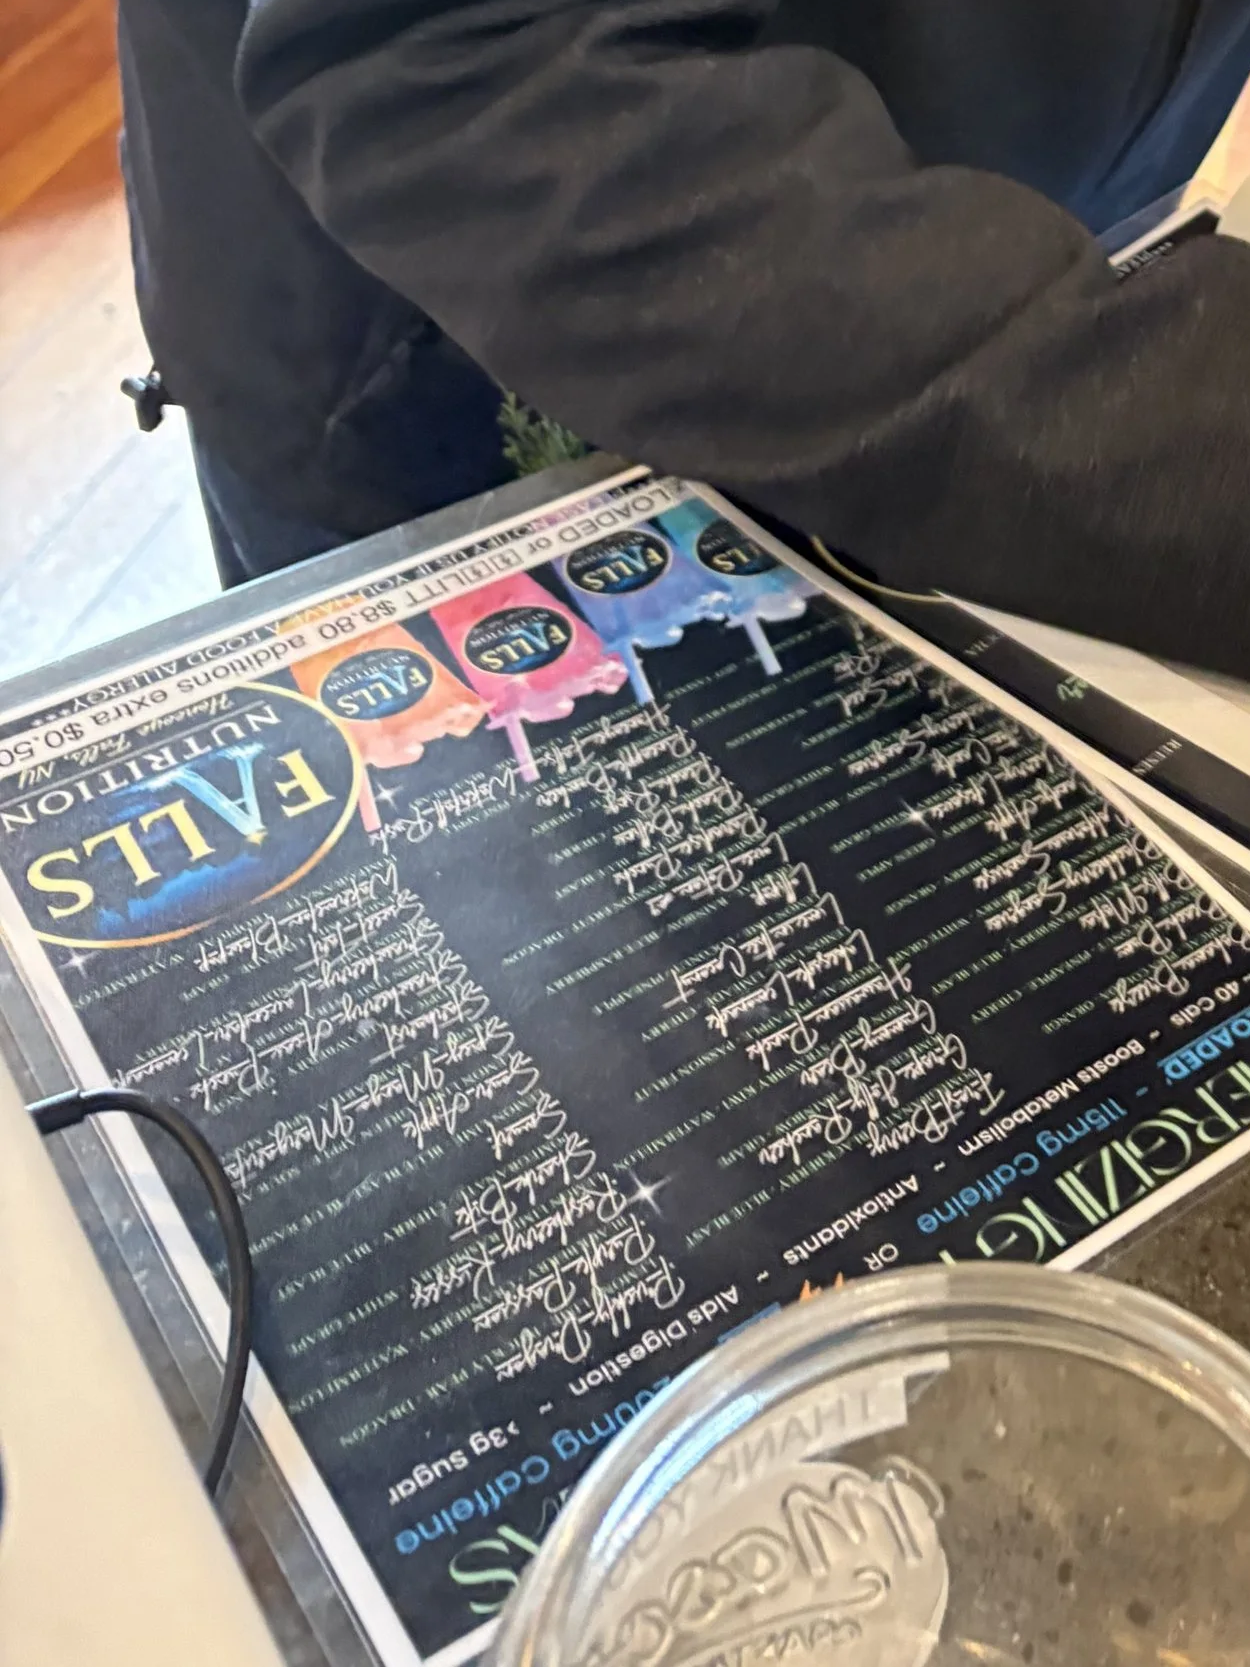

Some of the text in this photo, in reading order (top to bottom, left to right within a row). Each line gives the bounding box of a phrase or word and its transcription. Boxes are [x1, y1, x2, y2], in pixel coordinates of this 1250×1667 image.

[520, 534, 555, 554] or
[550, 487, 676, 544] LOADED
[313, 598, 400, 641] $8.80
[173, 632, 312, 699] additions
[88, 686, 172, 732] extra
[0, 703, 281, 834] NUTRITION
[20, 737, 334, 926] FALLS
[1094, 956, 1193, 1024] Breeze
[1166, 993, 1219, 1029] Cals
[1209, 977, 1246, 1003] 40
[1073, 1037, 1147, 1087] Boosts
[953, 1076, 1083, 1162] Metabolism
[1030, 1091, 1127, 1160] 115mg
[778, 1172, 924, 1270] Antioxidants
[911, 1147, 1044, 1239] Caffeine
[859, 1239, 902, 1274] OR
[564, 1314, 688, 1402] Digestion
[381, 1441, 469, 1511] Sugar
[392, 1449, 552, 1564] Caffeine
